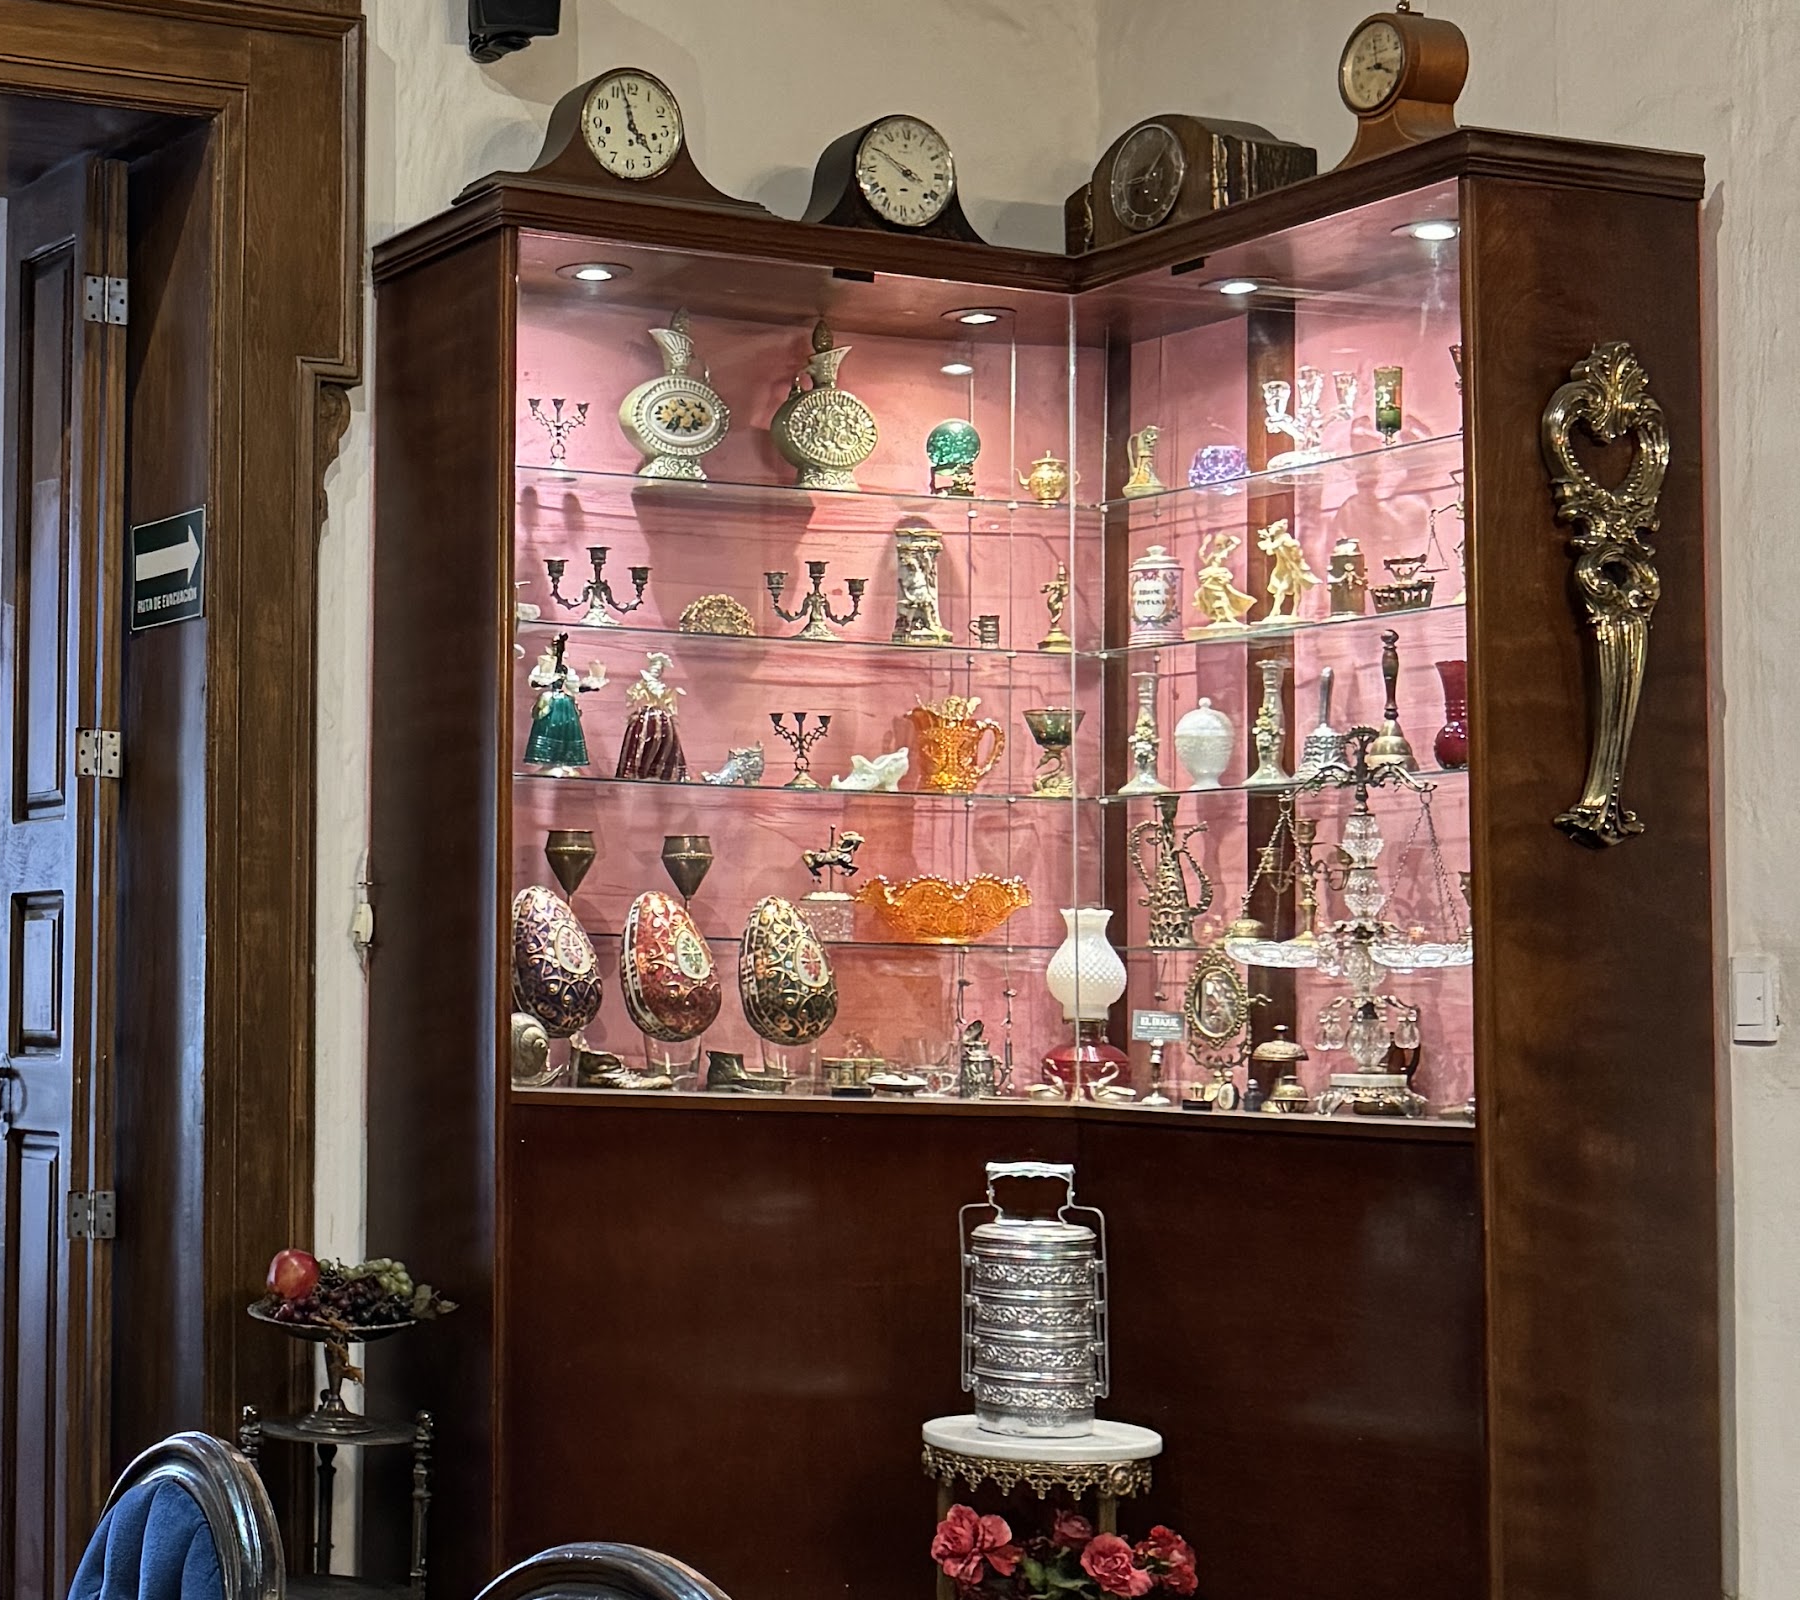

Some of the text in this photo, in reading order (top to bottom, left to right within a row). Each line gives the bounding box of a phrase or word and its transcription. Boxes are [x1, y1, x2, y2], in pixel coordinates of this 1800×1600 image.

[598, 98, 609, 110] 10
[610, 151, 618, 163] 7
[153, 595, 162, 610] DE
